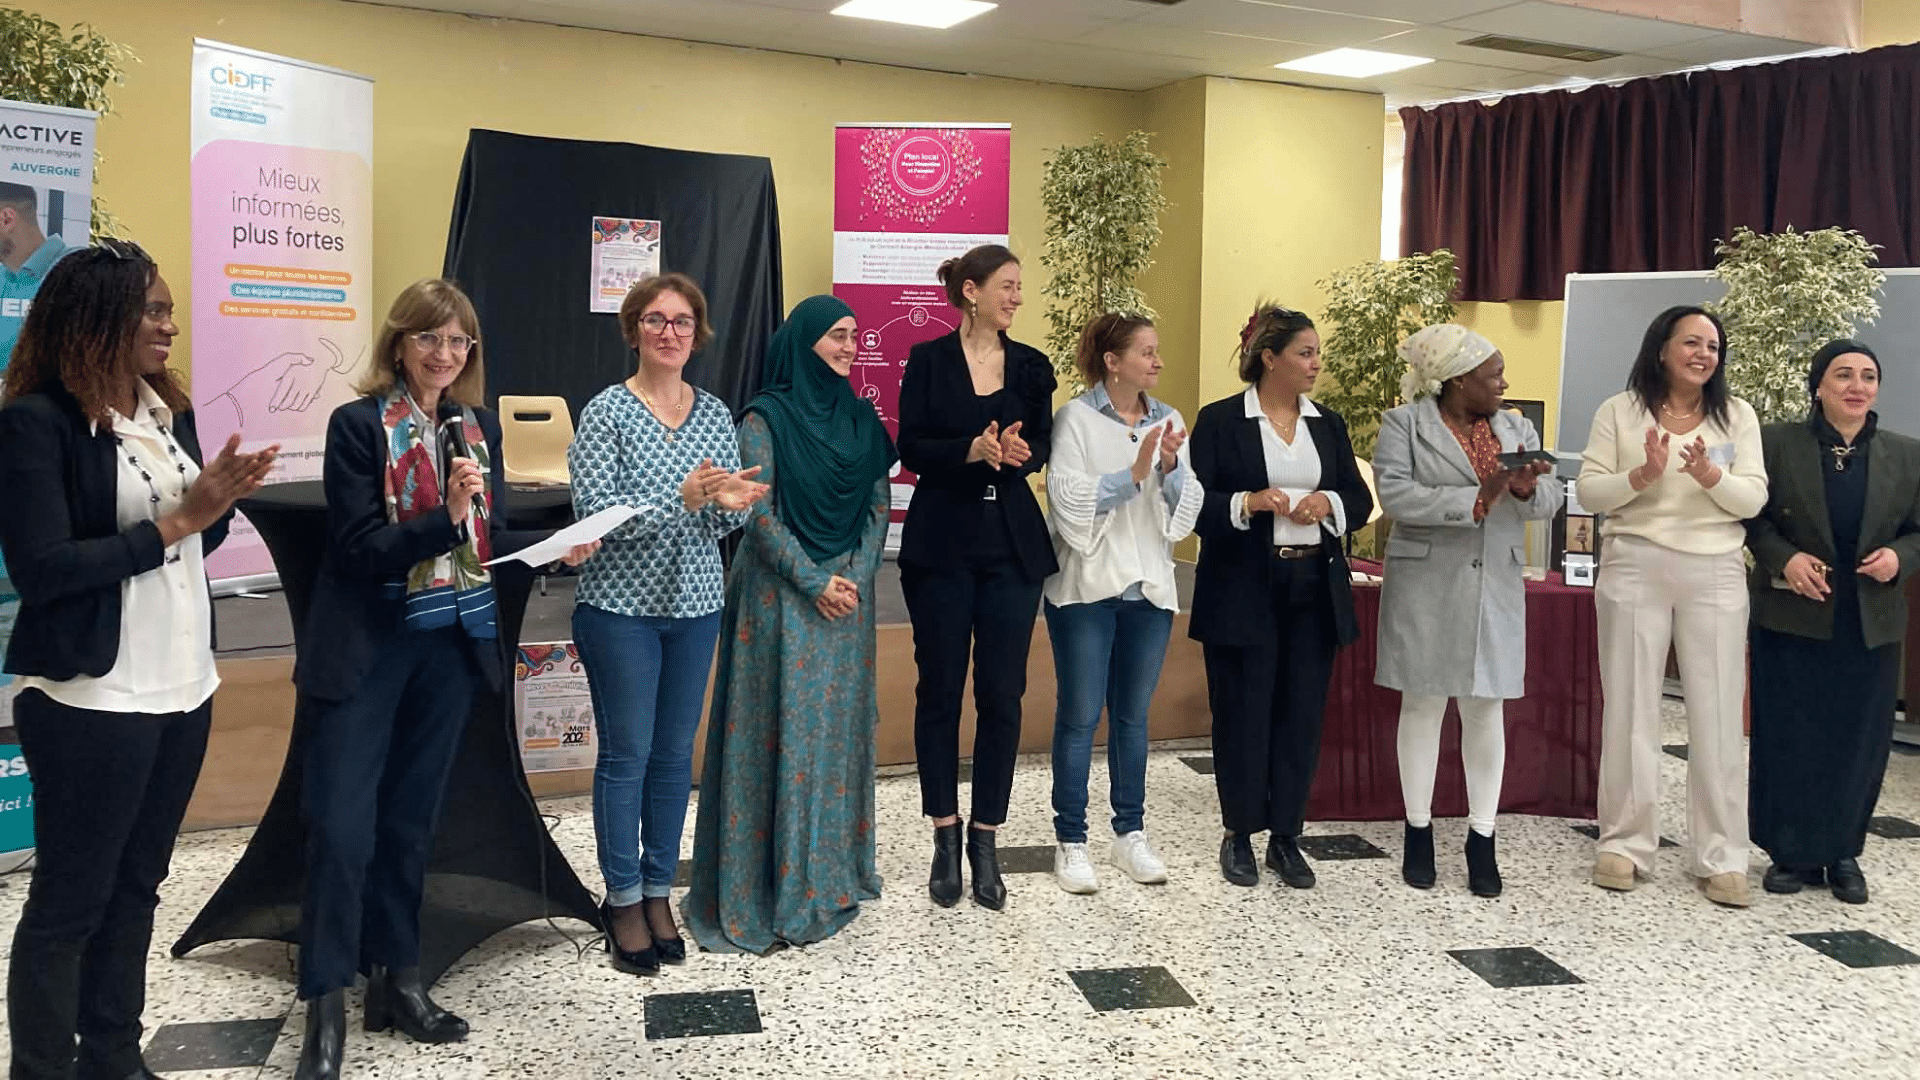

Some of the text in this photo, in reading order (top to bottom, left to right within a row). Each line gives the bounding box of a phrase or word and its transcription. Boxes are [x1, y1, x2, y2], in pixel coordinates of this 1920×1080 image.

[10, 162, 82, 177] AUVERGNE
[259, 166, 321, 194] Mieux
[232, 190, 345, 227] informées,
[233, 222, 345, 251] plus fortes
[569, 723, 590, 731] Mars
